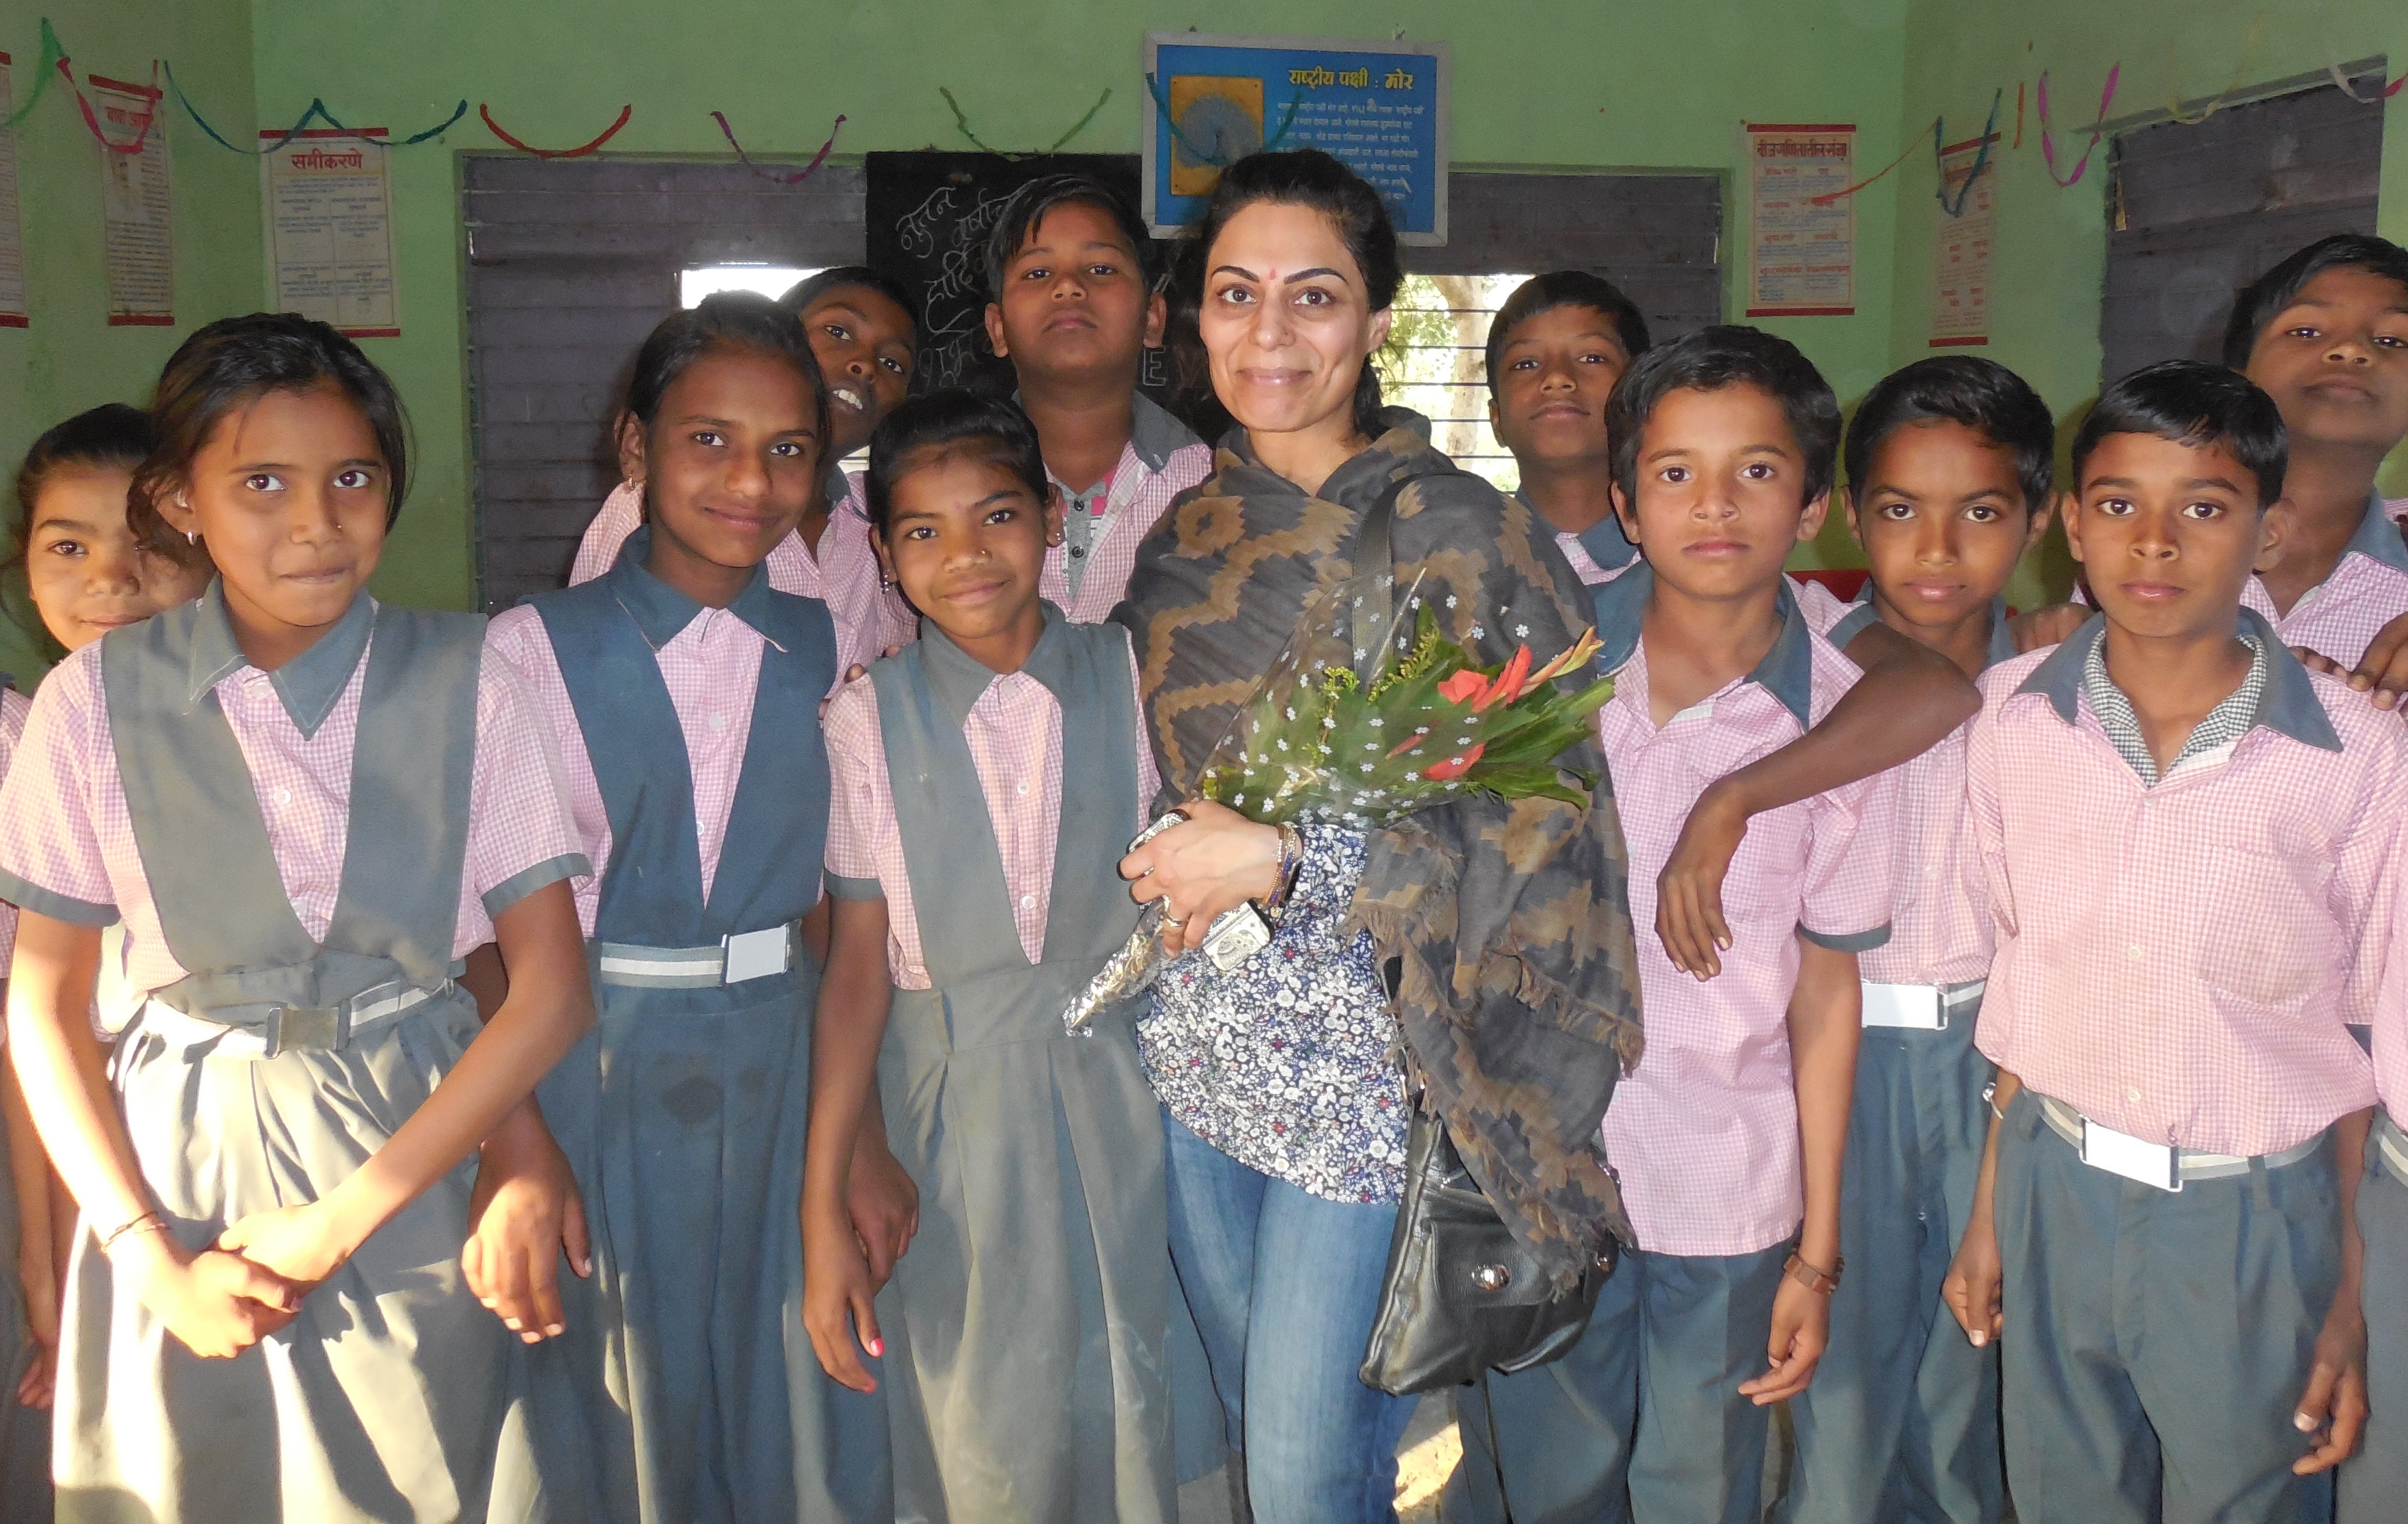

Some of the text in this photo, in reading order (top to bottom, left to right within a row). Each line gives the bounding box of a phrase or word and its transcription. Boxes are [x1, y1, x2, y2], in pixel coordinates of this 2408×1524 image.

[1288, 65, 1335, 89] राष्ट्रीय
[1339, 67, 1368, 88] पक्षी
[1384, 68, 1414, 90] मोर
[291, 148, 363, 170] समीकरणे
